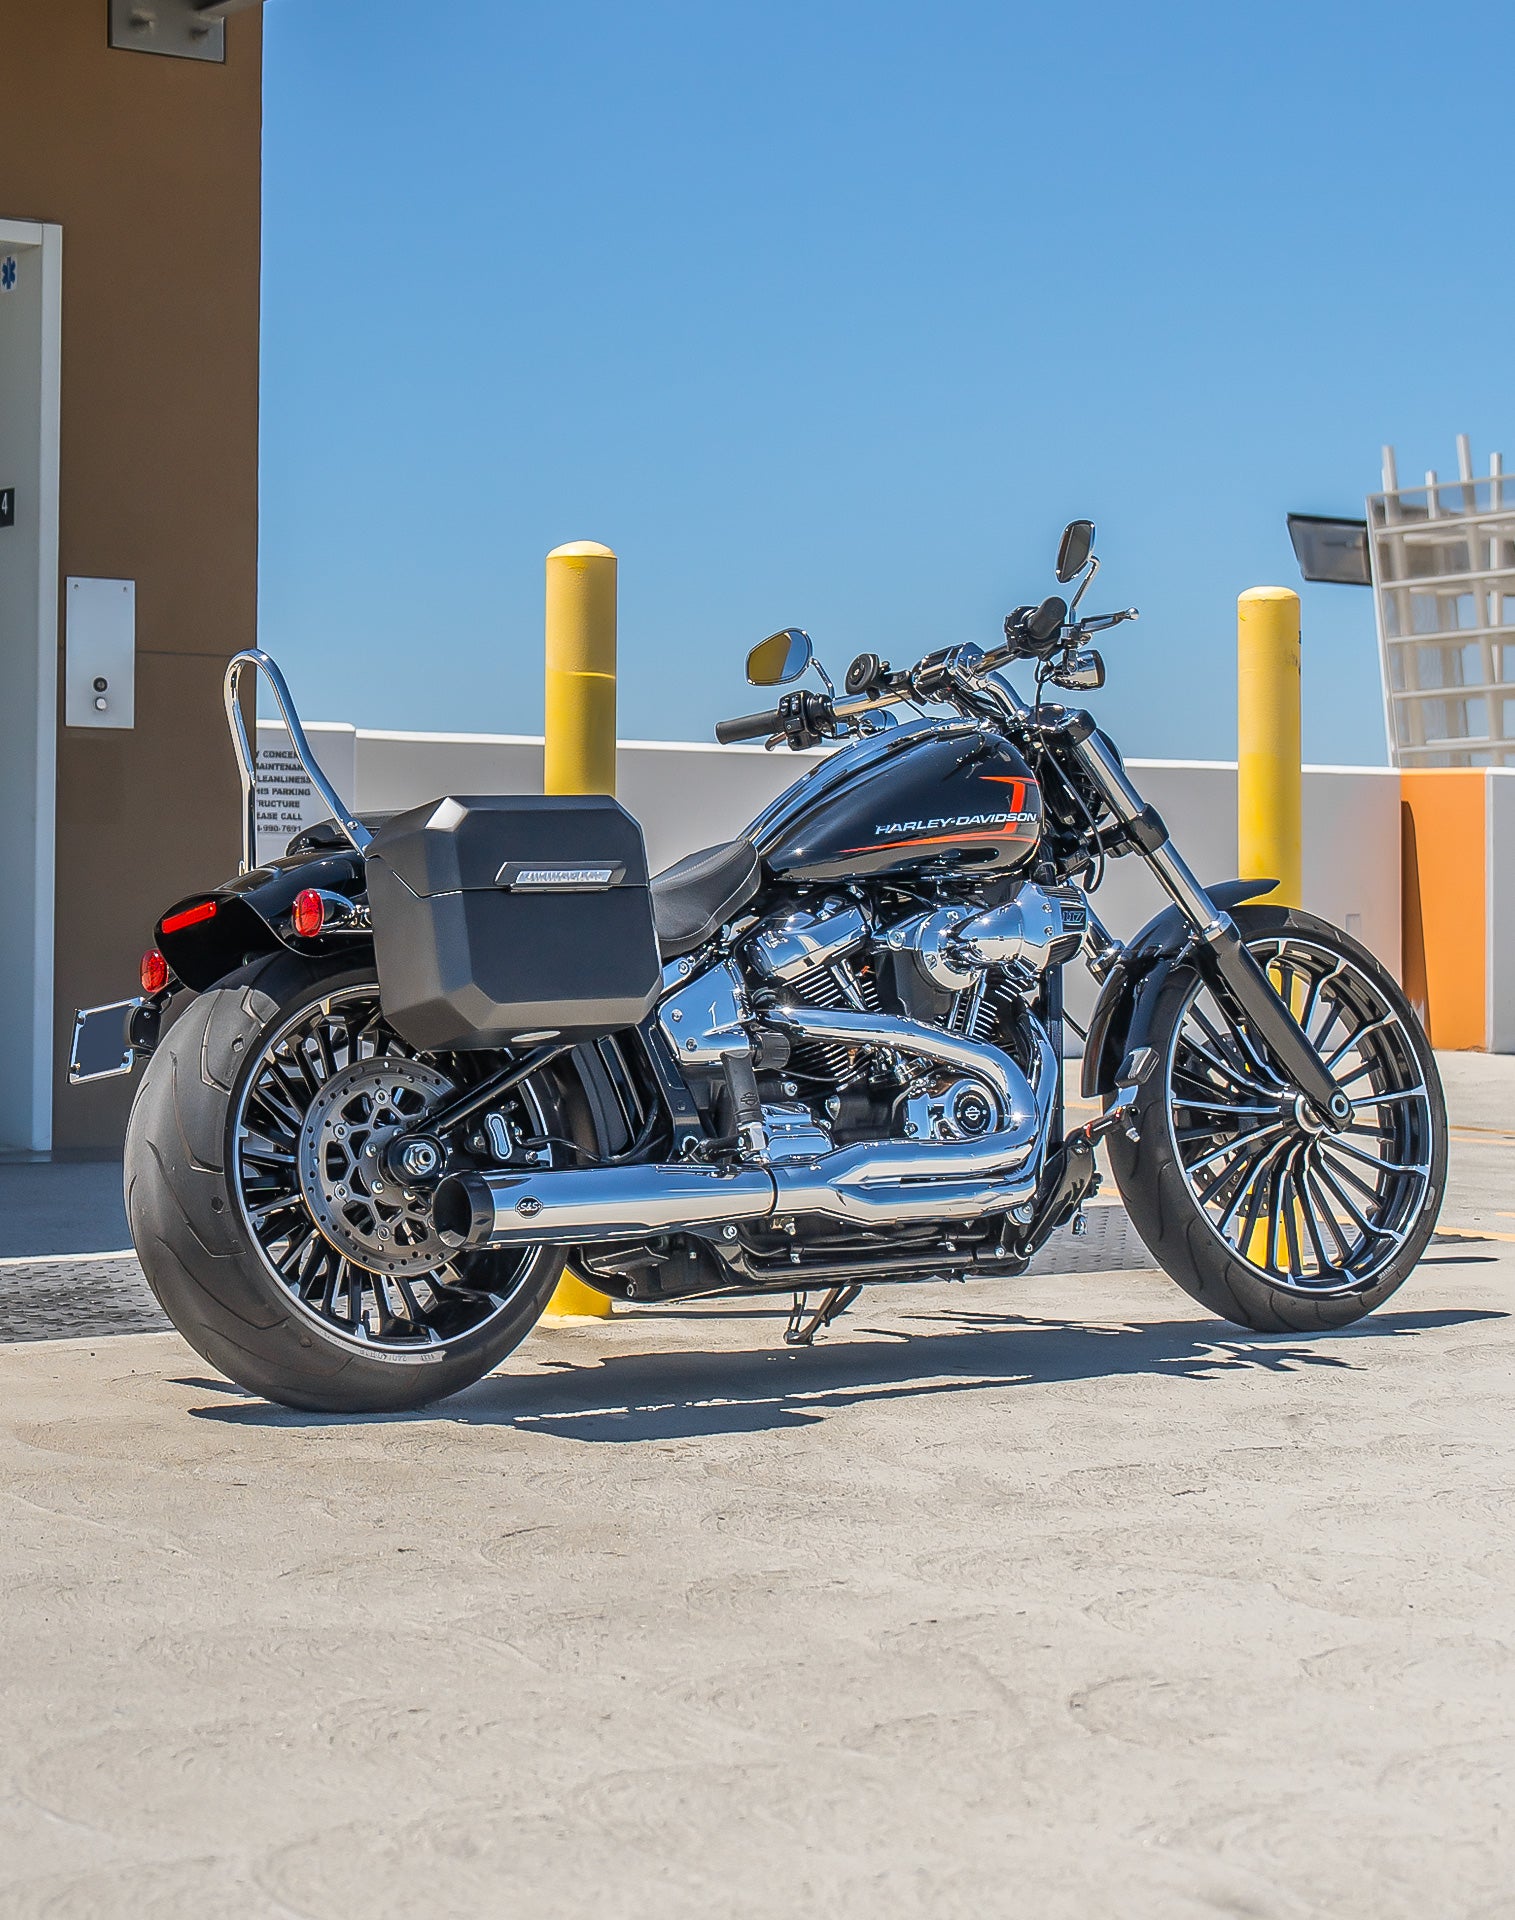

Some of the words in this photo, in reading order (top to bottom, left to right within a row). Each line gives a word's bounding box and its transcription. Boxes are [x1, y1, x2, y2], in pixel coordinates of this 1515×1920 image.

[2, 492, 8, 515] 4
[257, 800, 300, 809] RUCTURE
[281, 812, 303, 821] CALL
[875, 812, 1038, 835] HARLEY-DAVIDSON
[520, 1202, 539, 1212] S&S
